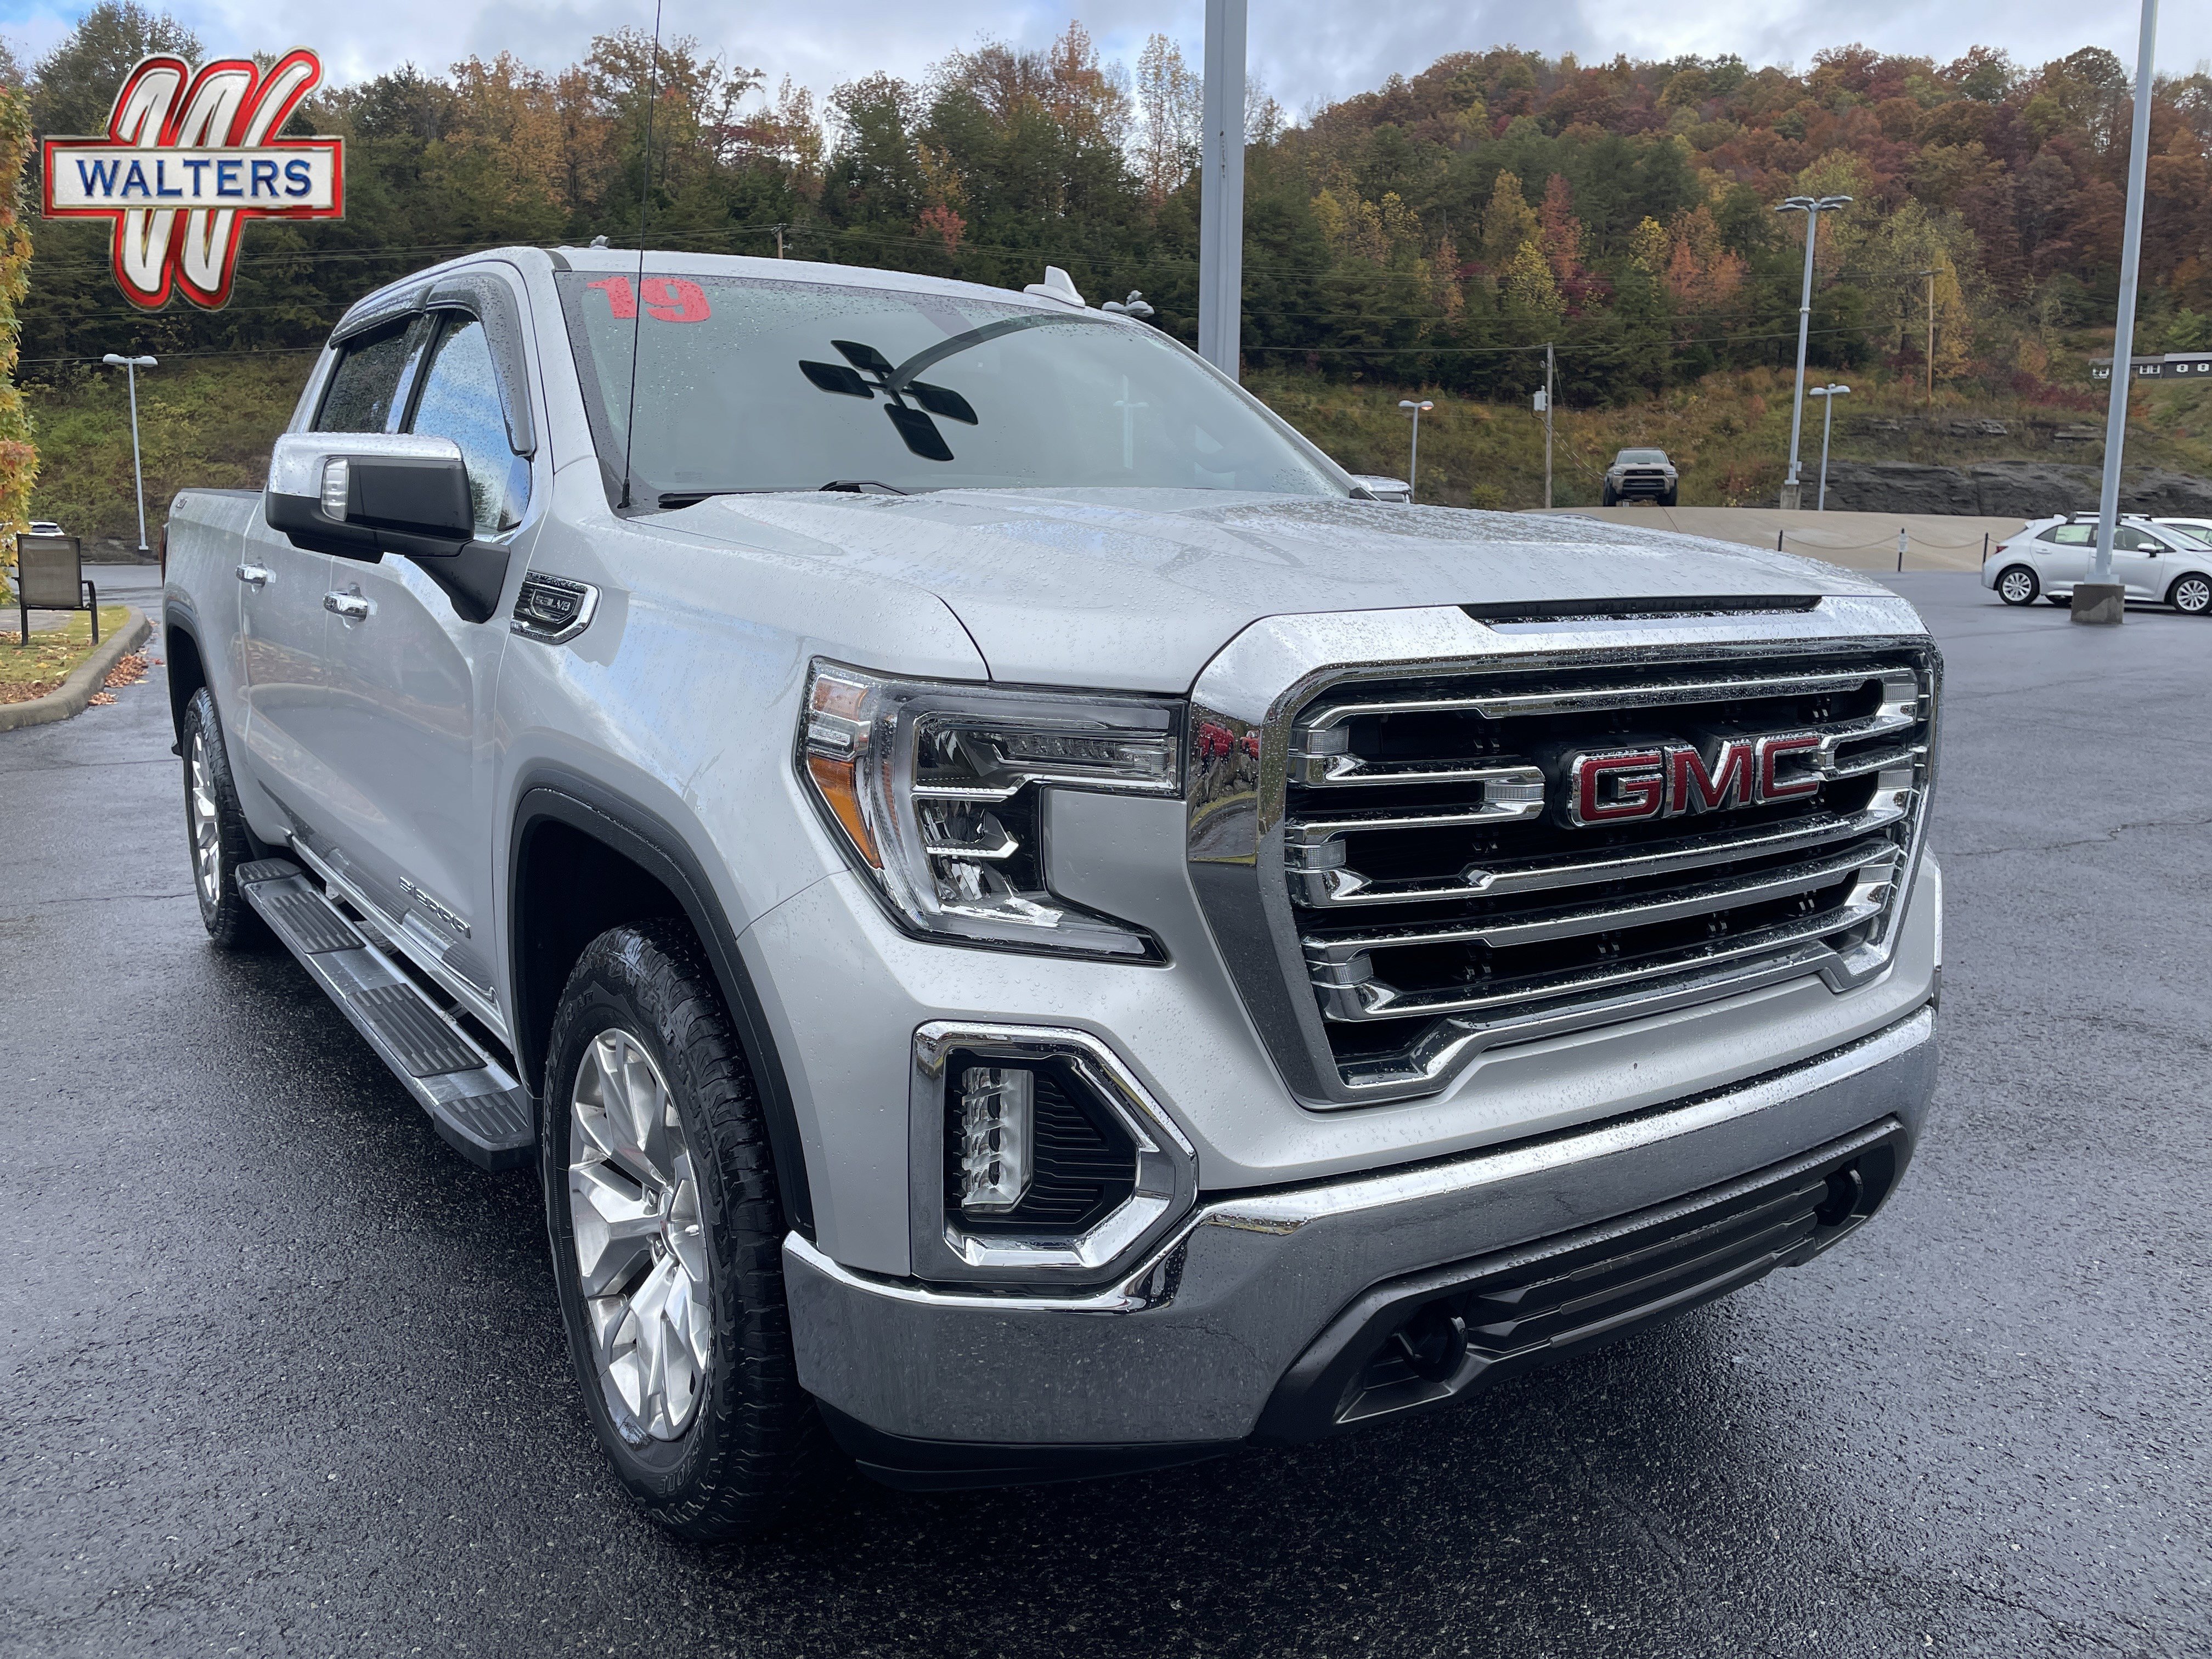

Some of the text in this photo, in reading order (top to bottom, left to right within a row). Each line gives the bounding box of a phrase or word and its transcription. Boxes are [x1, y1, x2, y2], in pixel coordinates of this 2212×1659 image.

[586, 276, 712, 323] 19
[1567, 732, 1821, 828] GMC
[399, 876, 471, 939] SIERRA
